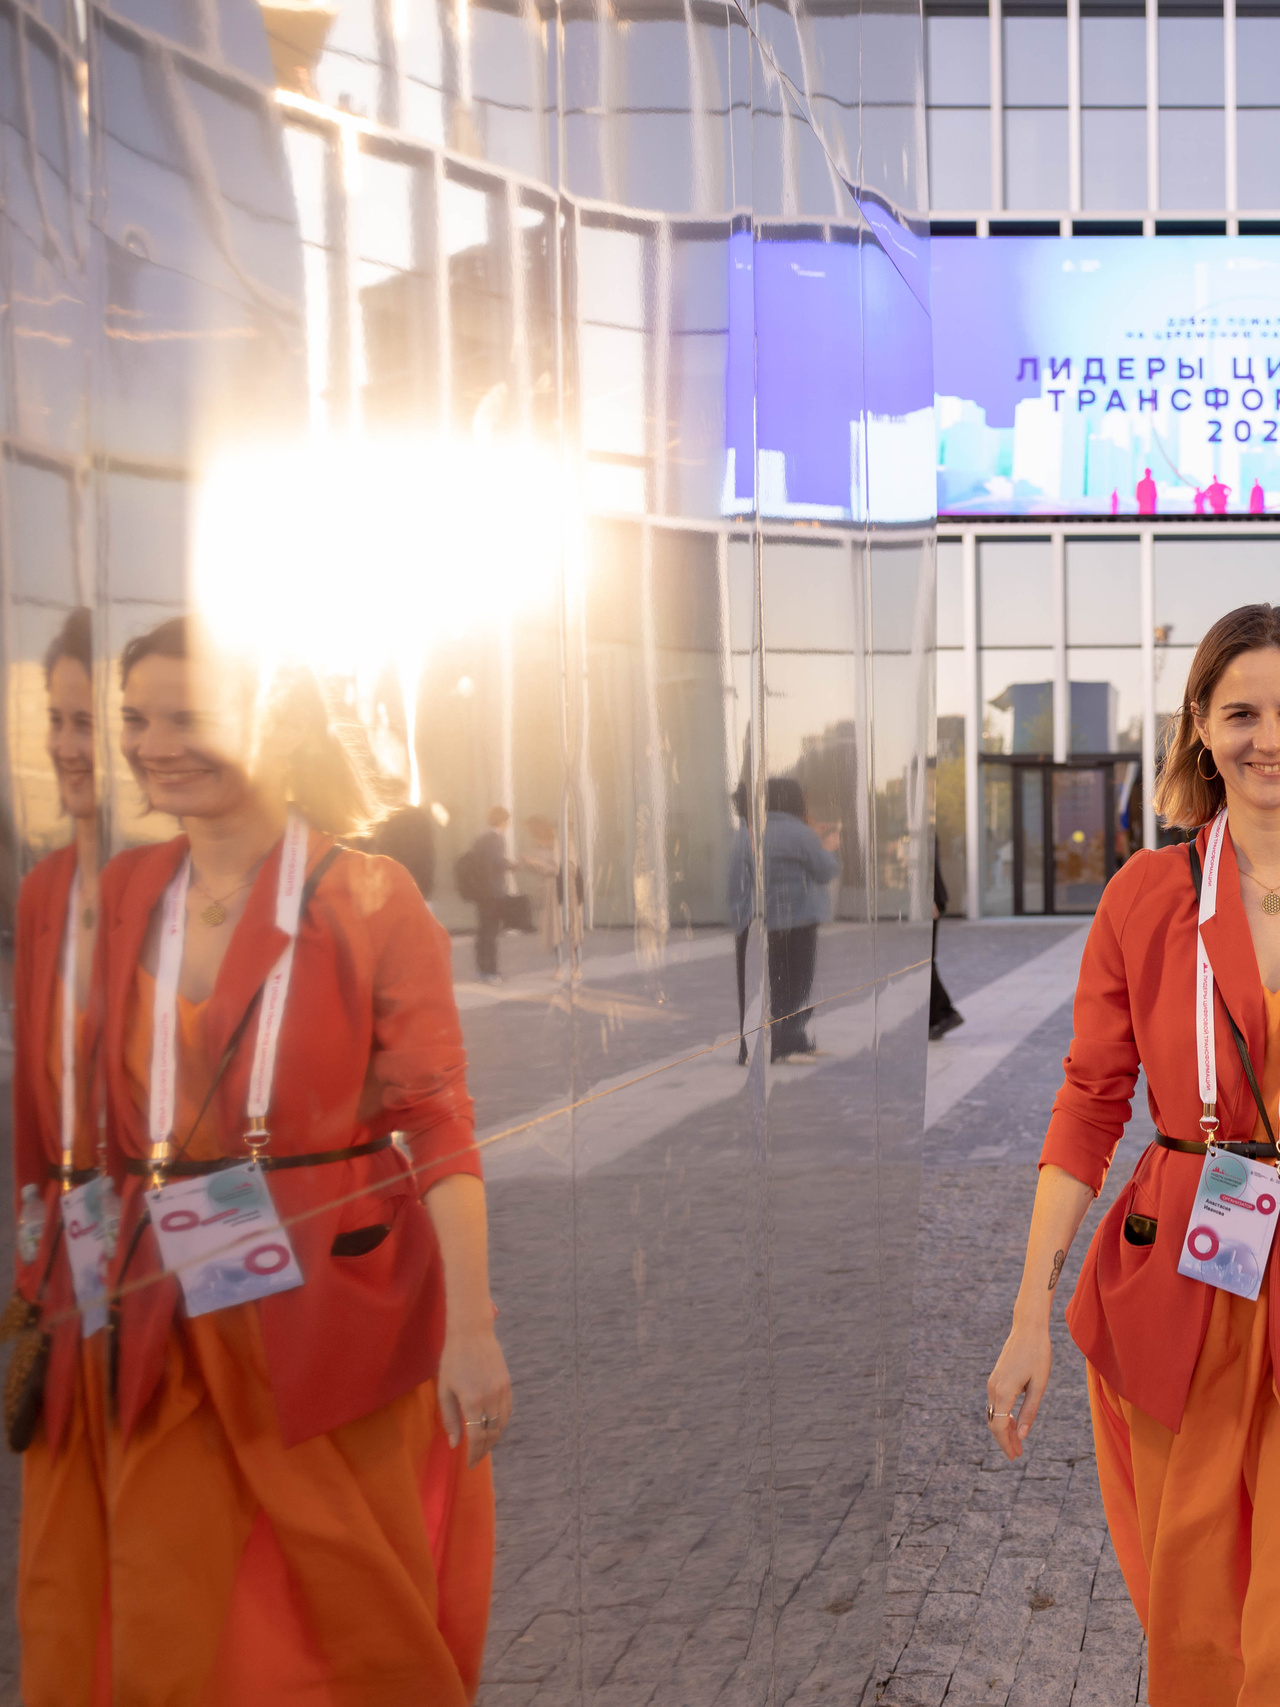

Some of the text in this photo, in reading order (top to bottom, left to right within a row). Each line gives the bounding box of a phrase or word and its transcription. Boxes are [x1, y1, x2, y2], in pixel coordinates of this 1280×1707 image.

[1015, 357, 1203, 385] ЛИДЕРЫ
[1208, 838, 1219, 887] ТРАНСФОРМАЦИИ
[1203, 1036, 1211, 1091] ТРАНСФОРМАЦИИ
[1203, 1204, 1225, 1216] Иванова
[1205, 1198, 1231, 1212] Анастасия
[1222, 1195, 1253, 1209] ОРГАНИЗАТОР
